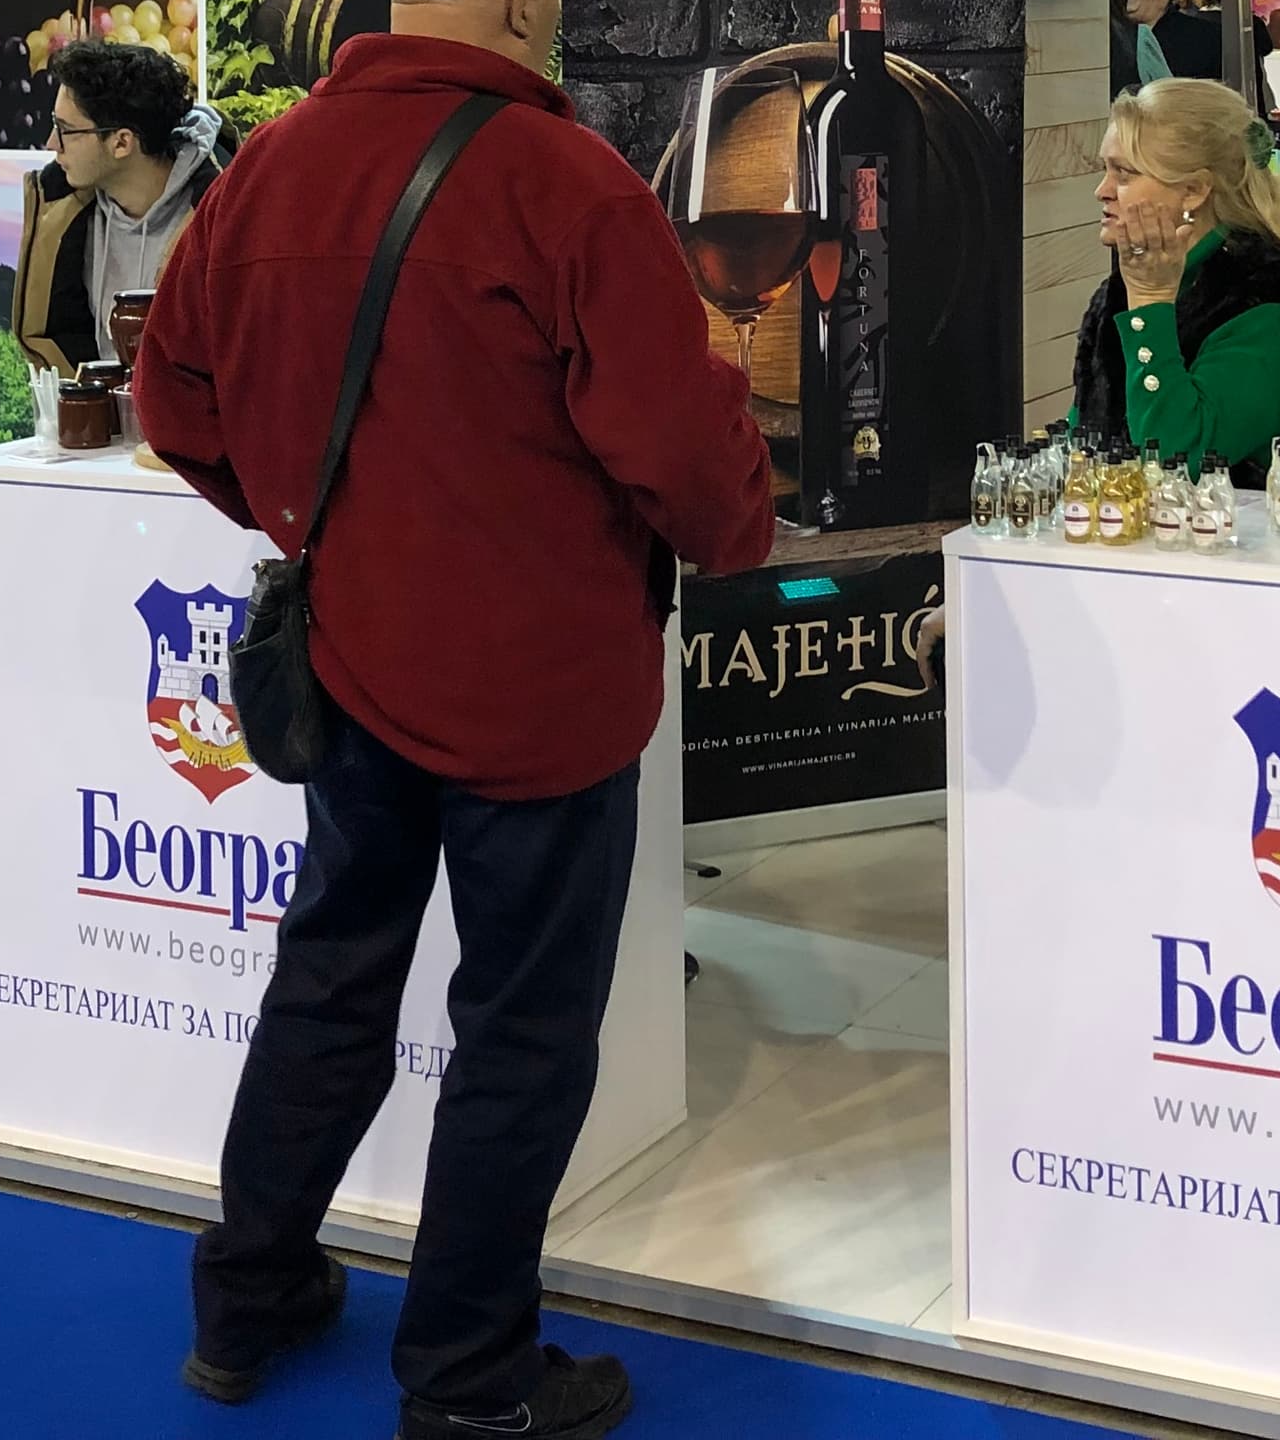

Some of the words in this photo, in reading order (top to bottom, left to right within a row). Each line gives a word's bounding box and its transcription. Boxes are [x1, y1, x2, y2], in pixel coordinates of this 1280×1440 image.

[857, 248, 871, 372] FORTUNA
[736, 727, 821, 746] DESTILERIJA
[837, 717, 897, 733] VINARIJA
[902, 710, 942, 724] MAJET
[76, 788, 307, 932] Београ
[77, 922, 279, 977] www.beogra
[181, 1004, 216, 1040] ЗА
